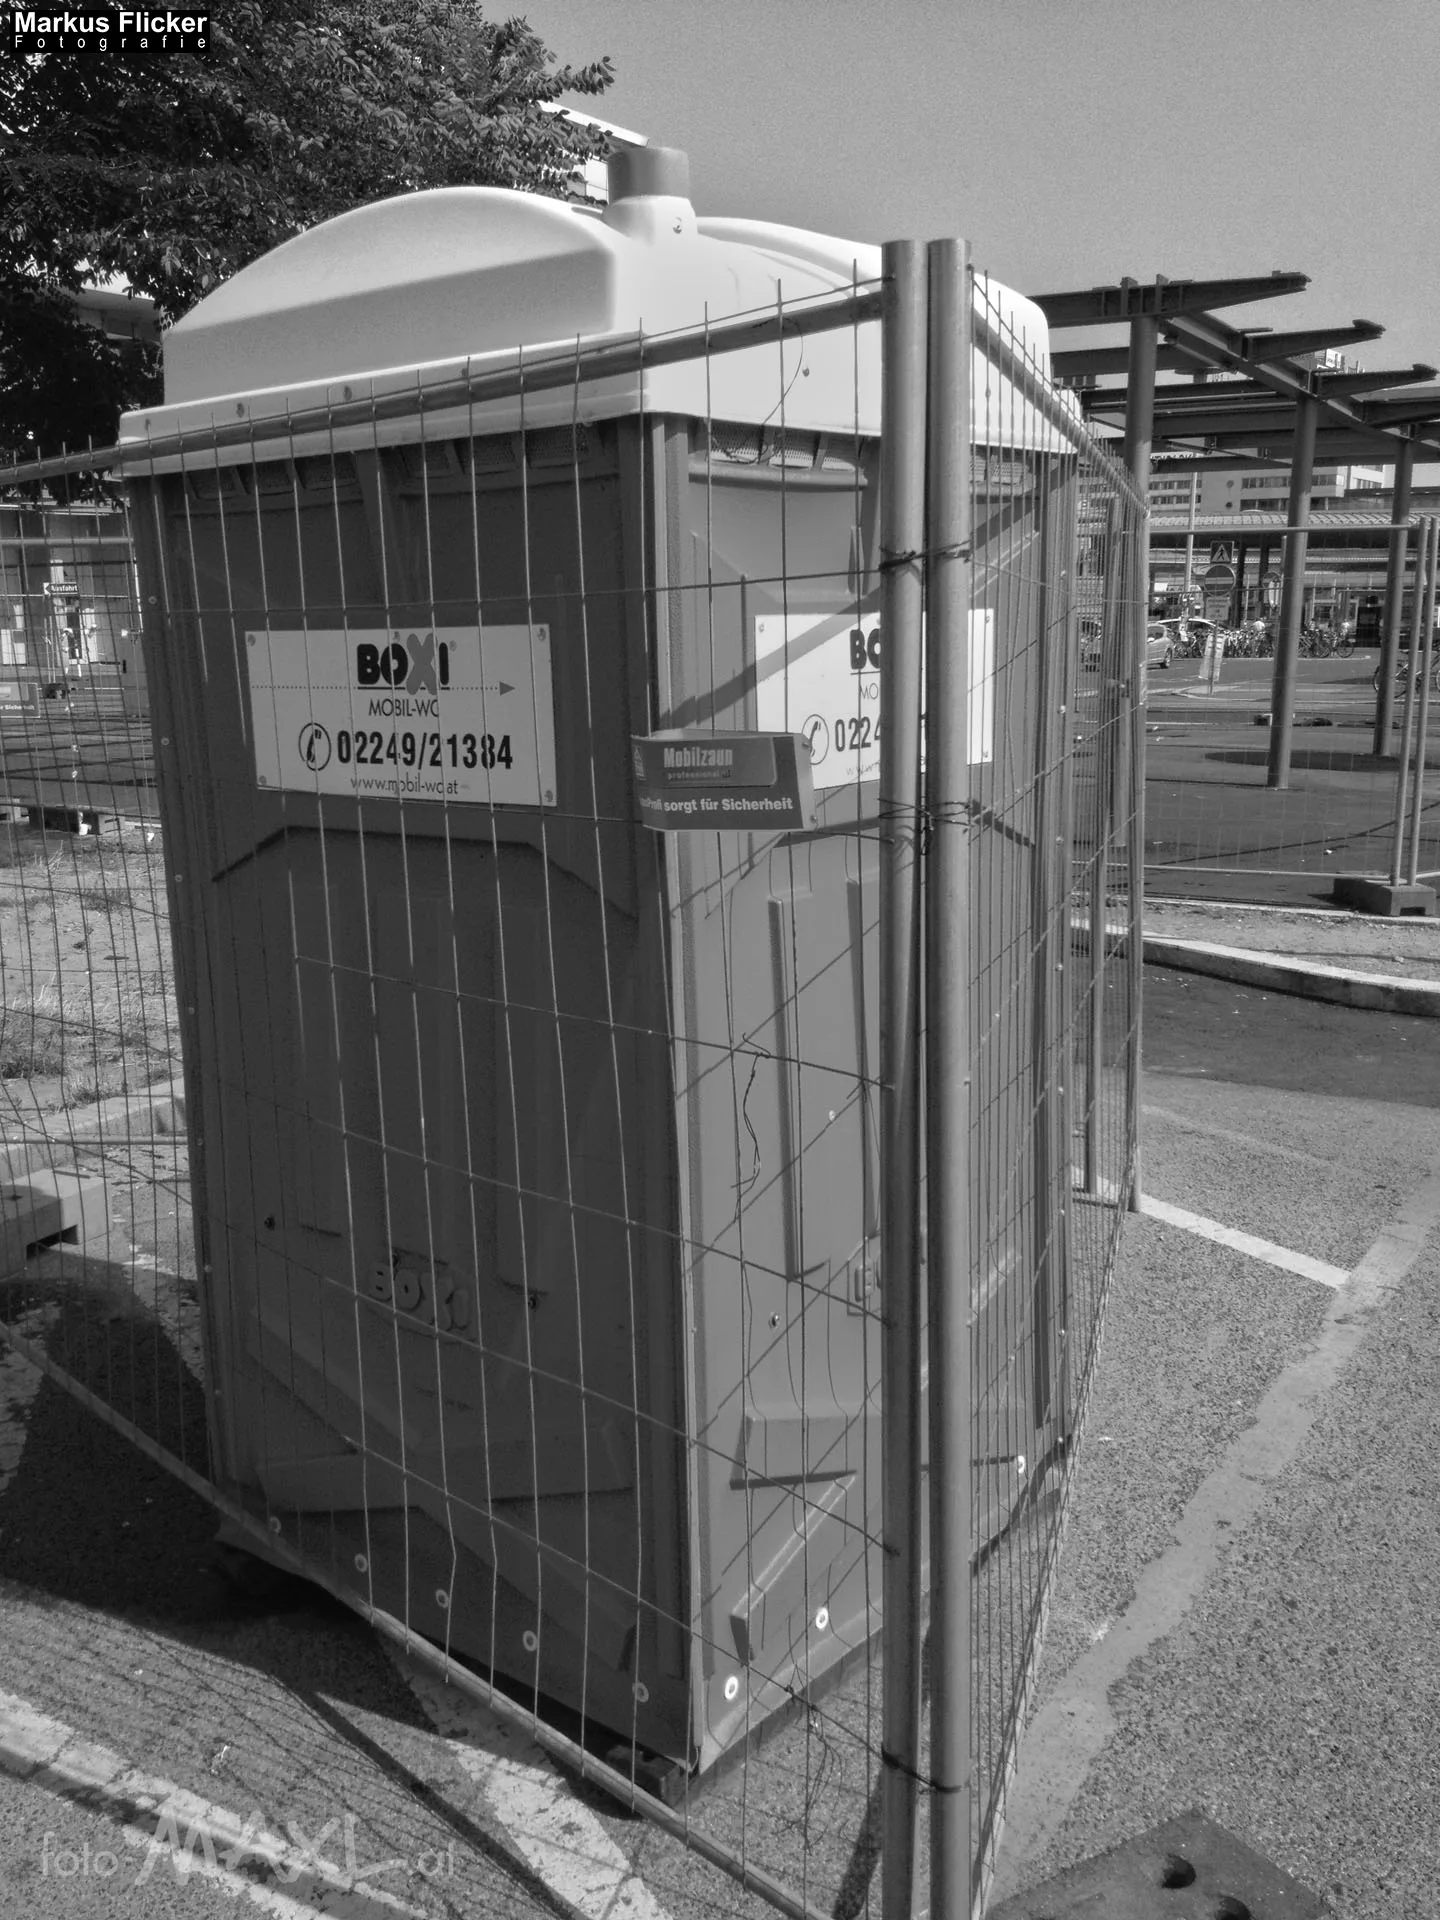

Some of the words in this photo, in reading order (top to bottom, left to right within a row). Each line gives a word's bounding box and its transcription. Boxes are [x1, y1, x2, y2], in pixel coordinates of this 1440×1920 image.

[849, 628, 881, 670] BO
[357, 632, 450, 696] BOXI
[368, 698, 440, 718] MOBIL-WC
[336, 730, 513, 770] 02249/21384
[663, 746, 733, 768] Mobilzaun
[350, 771, 459, 795] www.mobil-wcat
[663, 798, 698, 814] sorgt
[700, 797, 719, 811] für
[721, 797, 794, 811] Sicherheit
